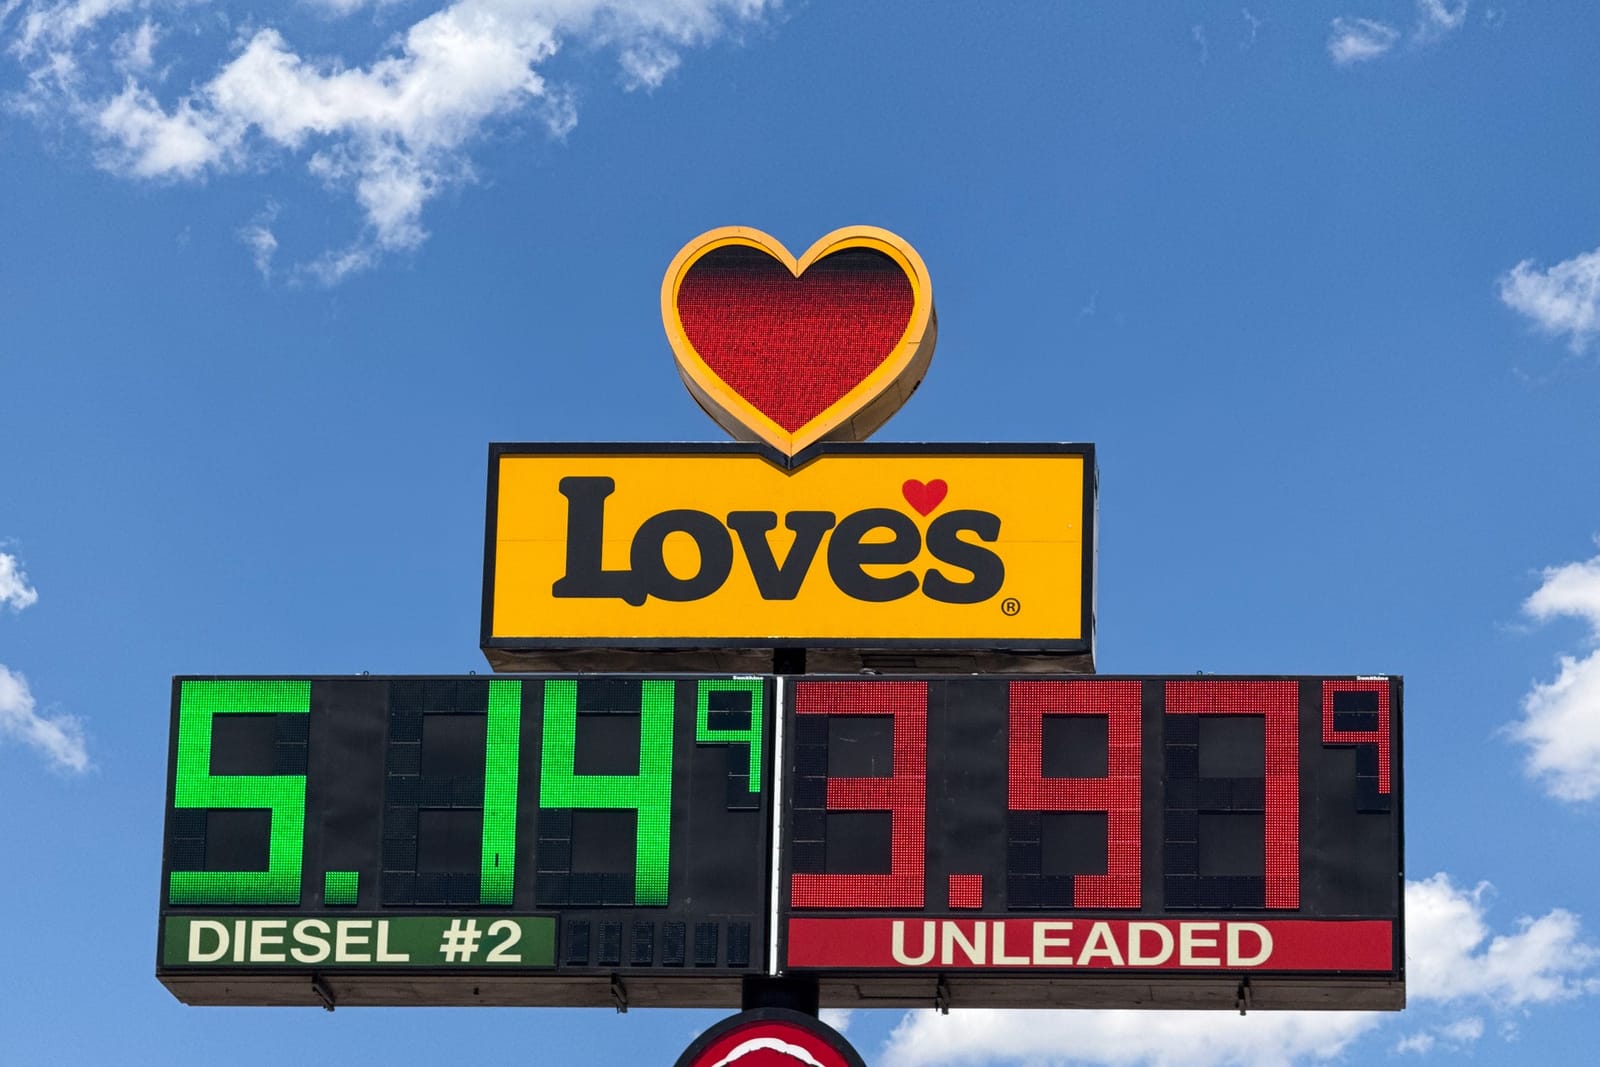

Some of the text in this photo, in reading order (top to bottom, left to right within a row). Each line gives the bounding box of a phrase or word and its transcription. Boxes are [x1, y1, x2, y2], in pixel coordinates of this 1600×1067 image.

[188, 919, 522, 964] DIESEL #2
[892, 920, 1274, 966] UNLEADED
